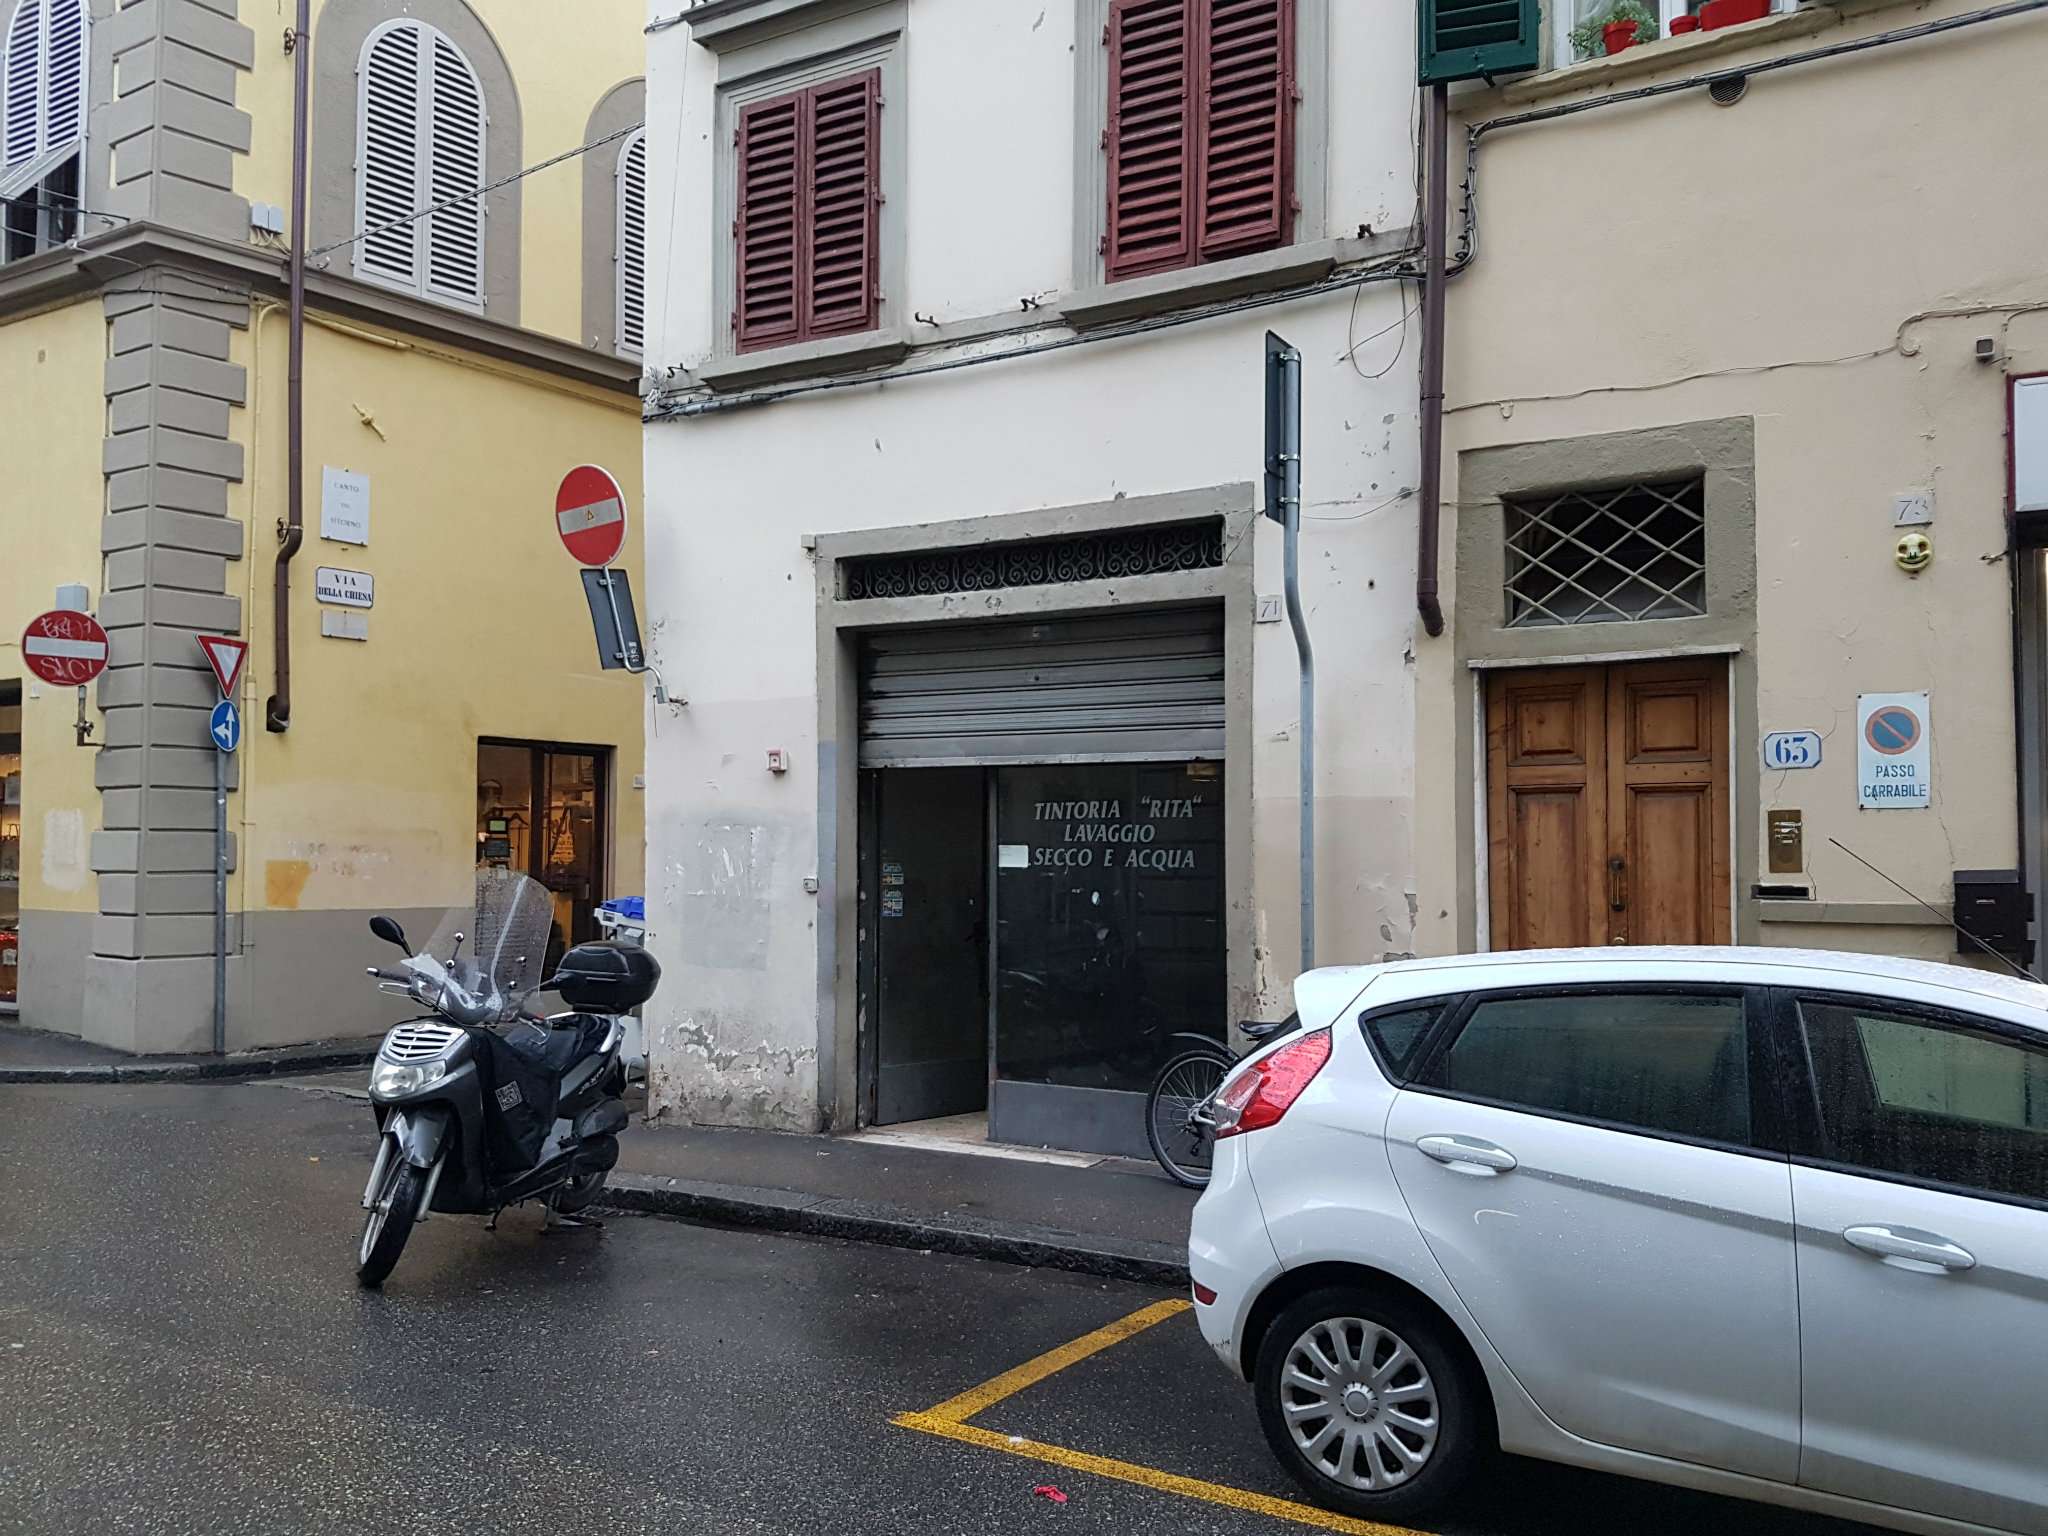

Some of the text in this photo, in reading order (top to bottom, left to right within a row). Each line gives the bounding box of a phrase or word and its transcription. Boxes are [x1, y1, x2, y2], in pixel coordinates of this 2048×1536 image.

[333, 482, 360, 493] CANTO
[334, 574, 357, 587] VIA
[318, 586, 372, 602] DELLA CHIESA
[1260, 599, 1277, 618] 71
[1875, 764, 1915, 779] PASSO
[1863, 783, 1927, 799] CARRABILE
[1033, 800, 1121, 821] TINTORIA
[1063, 823, 1156, 843] LAVAGGIO
[1033, 847, 1196, 872] SECCO E ACQUA
